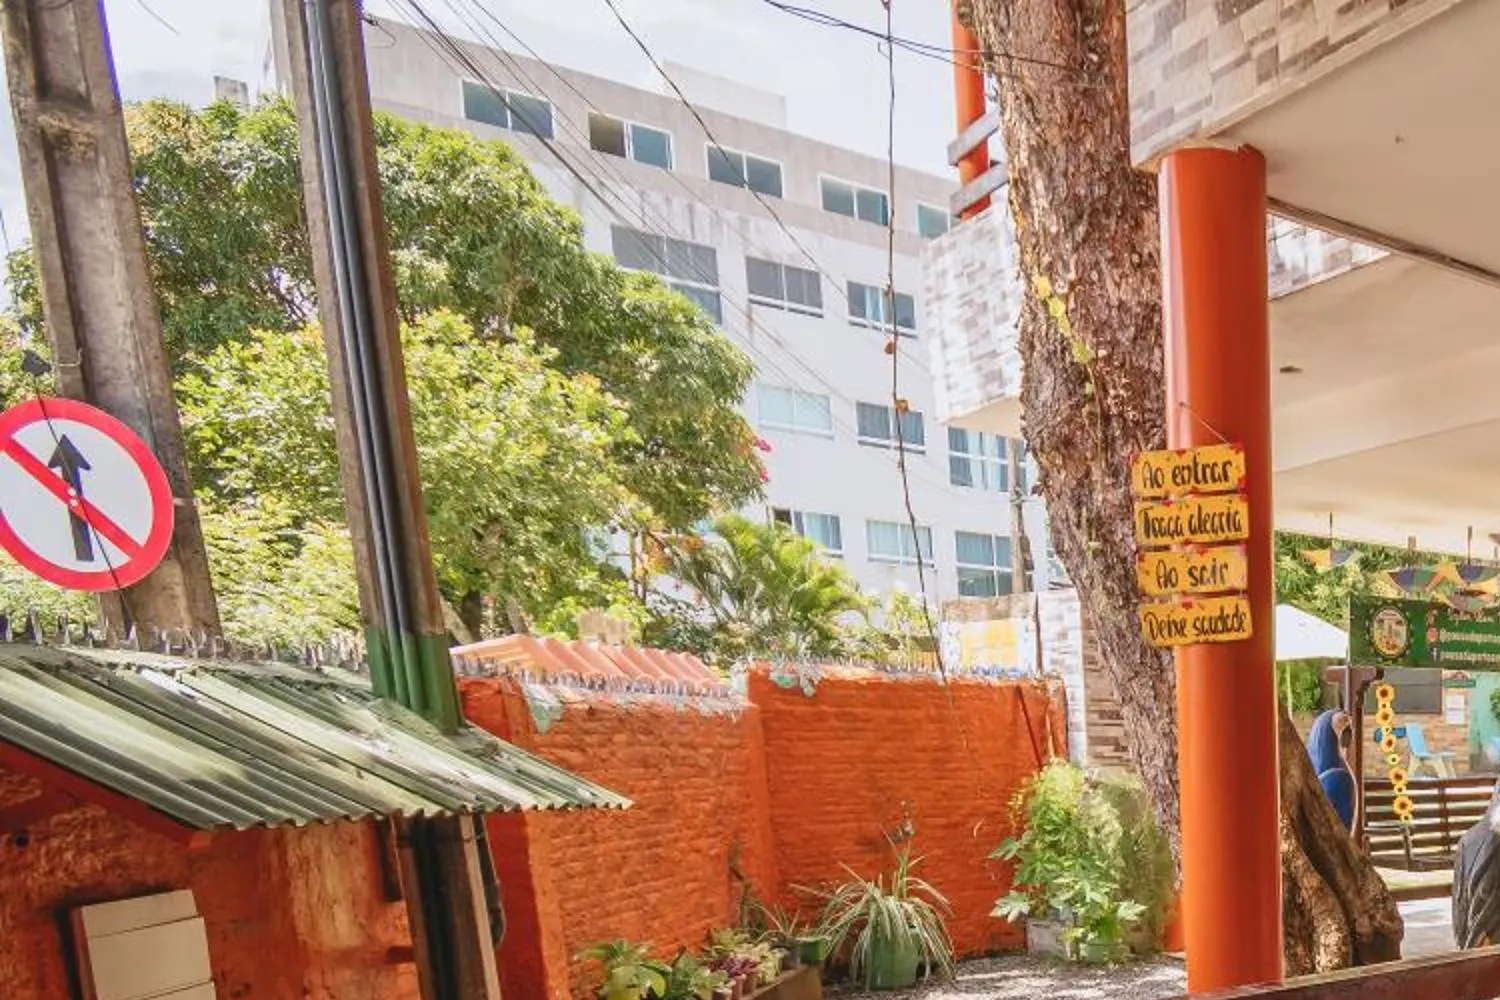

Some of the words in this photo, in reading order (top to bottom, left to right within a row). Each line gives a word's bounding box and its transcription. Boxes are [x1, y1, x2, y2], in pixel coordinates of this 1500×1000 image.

[1143, 461, 1164, 488] Ao
[1172, 453, 1232, 487] entrar
[1188, 502, 1242, 536] alegria
[1156, 559, 1178, 589] Ao
[1189, 557, 1229, 587] sair
[1144, 610, 1187, 640] Deixe
[1193, 603, 1247, 637] saudade
